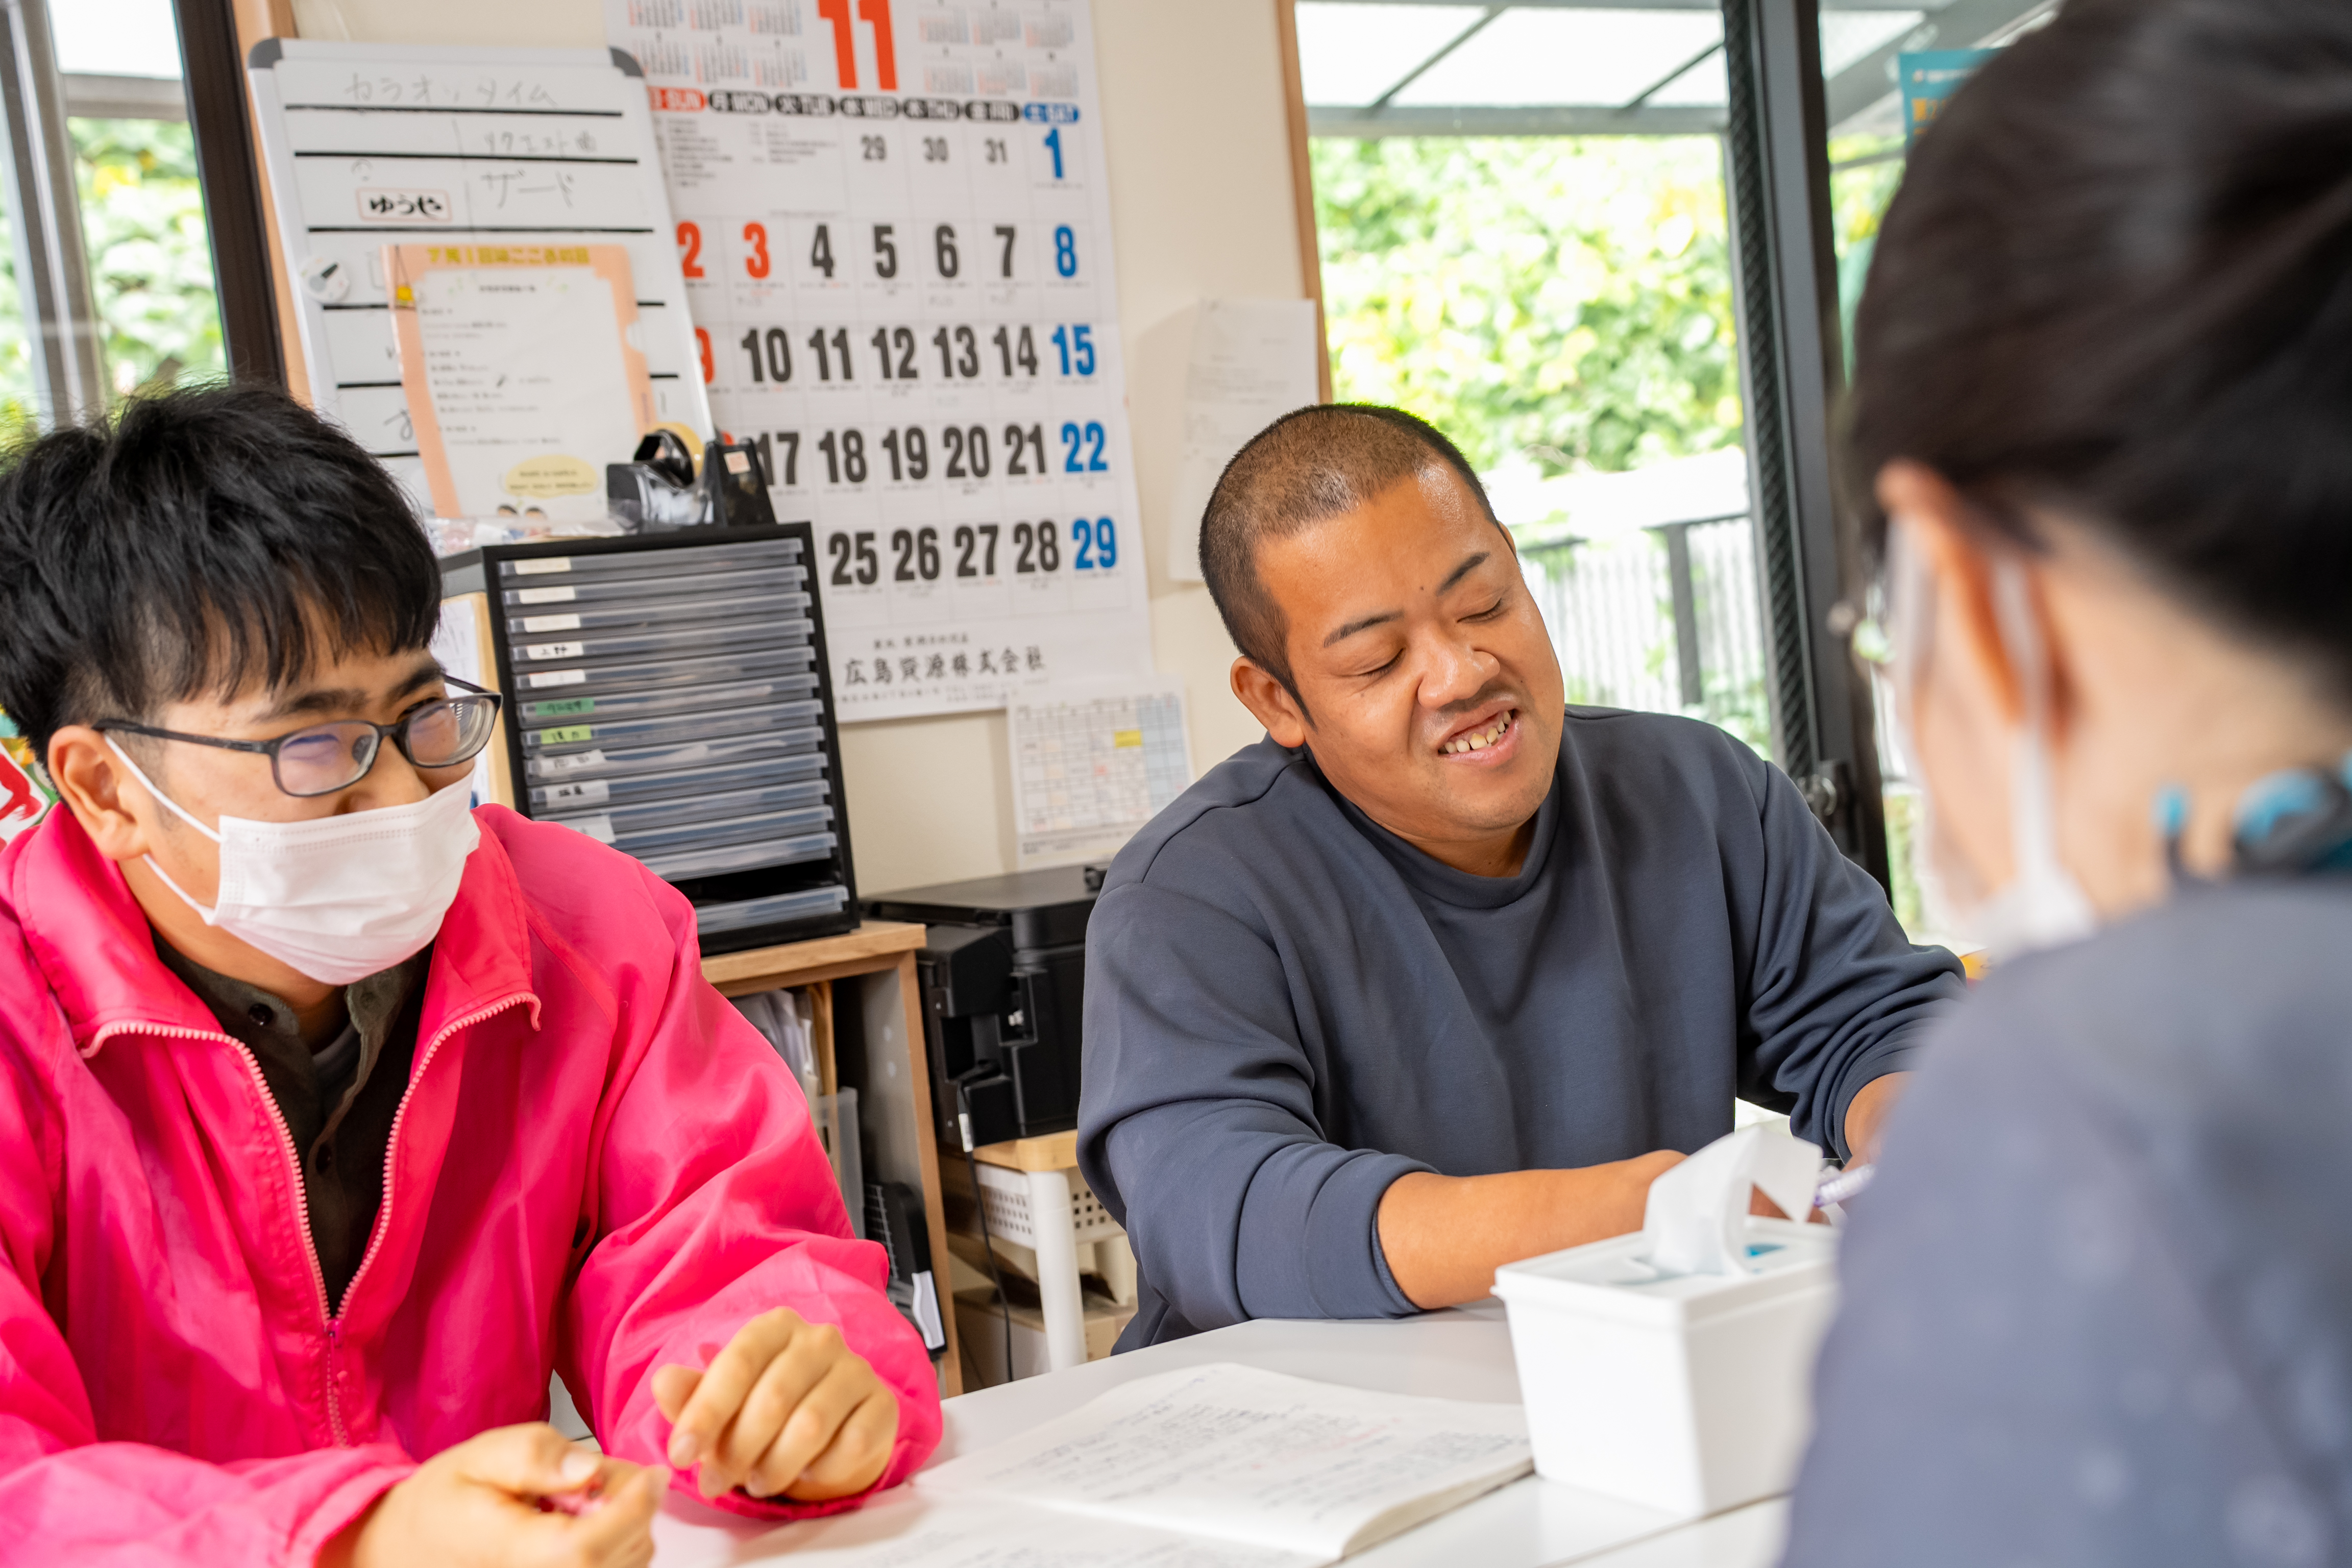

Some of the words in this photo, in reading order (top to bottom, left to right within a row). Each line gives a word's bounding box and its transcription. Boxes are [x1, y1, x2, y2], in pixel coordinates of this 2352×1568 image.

[818, 0, 897, 90] 11
[861, 134, 888, 161] 29
[923, 136, 949, 163] 30
[985, 137, 1008, 164] 31
[1044, 128, 1064, 179] 1
[369, 193, 443, 219] ゆうや
[677, 221, 704, 279] 2
[744, 222, 770, 279] 3
[811, 225, 834, 278] 4
[873, 225, 897, 279] 5
[935, 225, 958, 278] 6
[995, 226, 1015, 278] 7
[1055, 226, 1076, 278] 8
[741, 327, 792, 383] 10
[808, 327, 852, 381] 11
[871, 327, 918, 379] 12
[933, 326, 978, 378] 13
[993, 326, 1038, 377] 14
[1052, 325, 1095, 376] 15
[758, 432, 799, 485] 17
[818, 429, 867, 483] 18
[882, 427, 928, 481] 19
[943, 426, 990, 478] 20
[1004, 424, 1046, 475] 21
[1062, 422, 1108, 472] 22
[828, 531, 878, 586] 25
[892, 527, 940, 581] 26
[954, 524, 999, 578] 27
[1013, 520, 1060, 573] 28
[1072, 517, 1116, 569] 29
